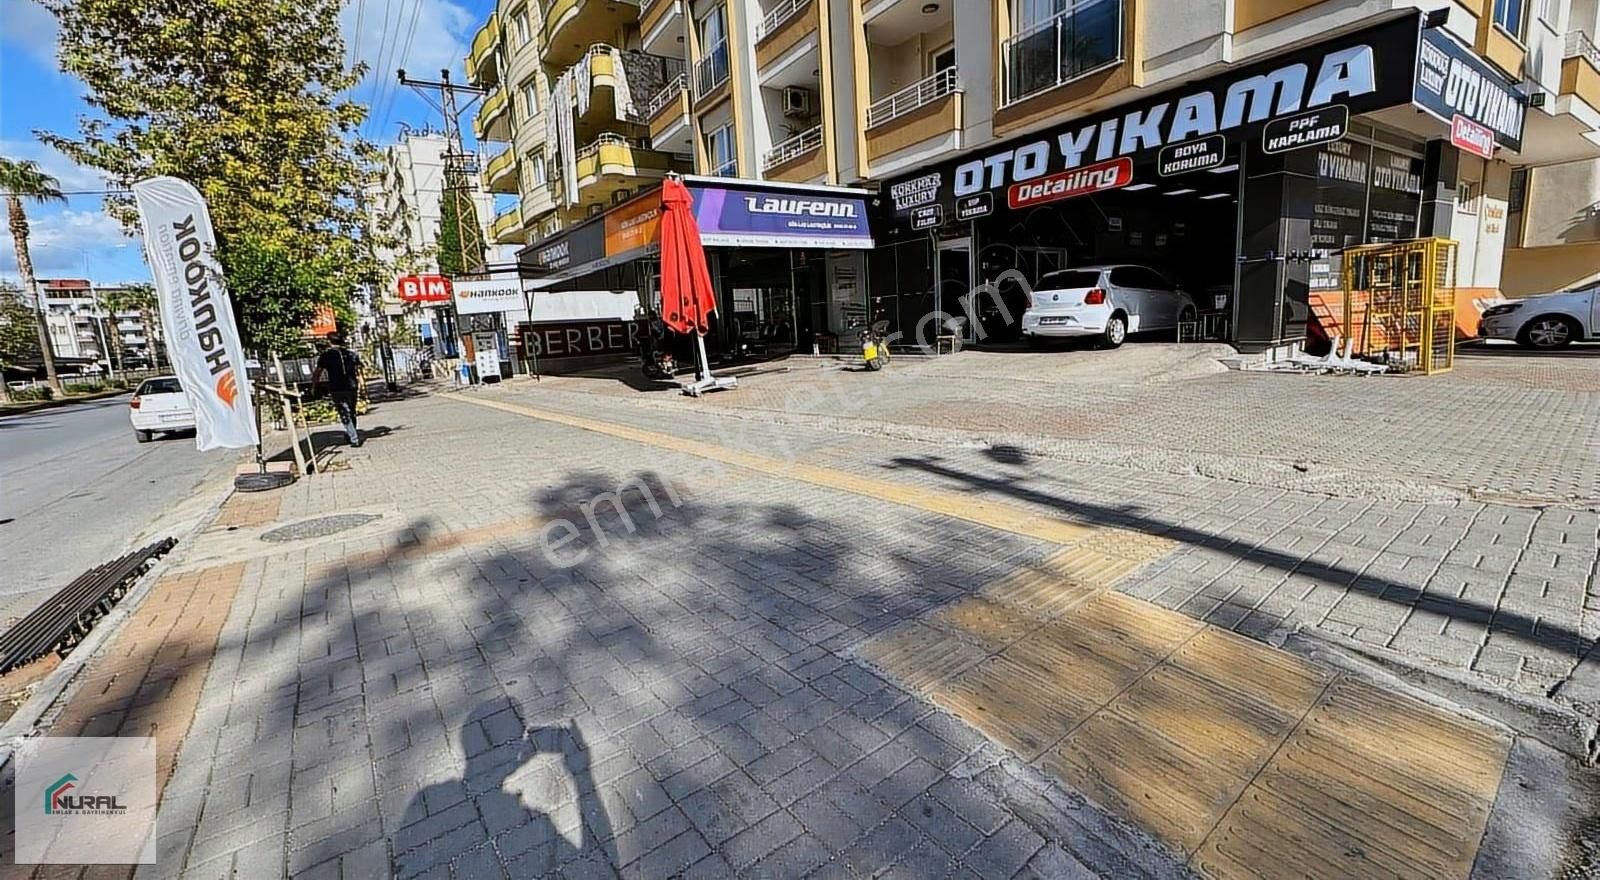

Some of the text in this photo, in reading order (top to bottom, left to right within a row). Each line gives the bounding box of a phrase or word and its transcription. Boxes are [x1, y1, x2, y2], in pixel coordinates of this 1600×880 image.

[1444, 58, 1523, 140] OTO YIKAMA
[1268, 125, 1340, 149] KAPLAMA
[1289, 115, 1320, 132] PPF
[1455, 119, 1491, 155] Detailing
[1164, 153, 1218, 173] KORUMA
[1175, 142, 1207, 158] BOYA
[954, 140, 1050, 196] OTO
[1329, 153, 1366, 184] YIKAMA
[1374, 166, 1391, 189] OTO
[1018, 166, 1119, 201] Detailing
[896, 187, 937, 210] LUXURY
[523, 321, 641, 358] BERBER
